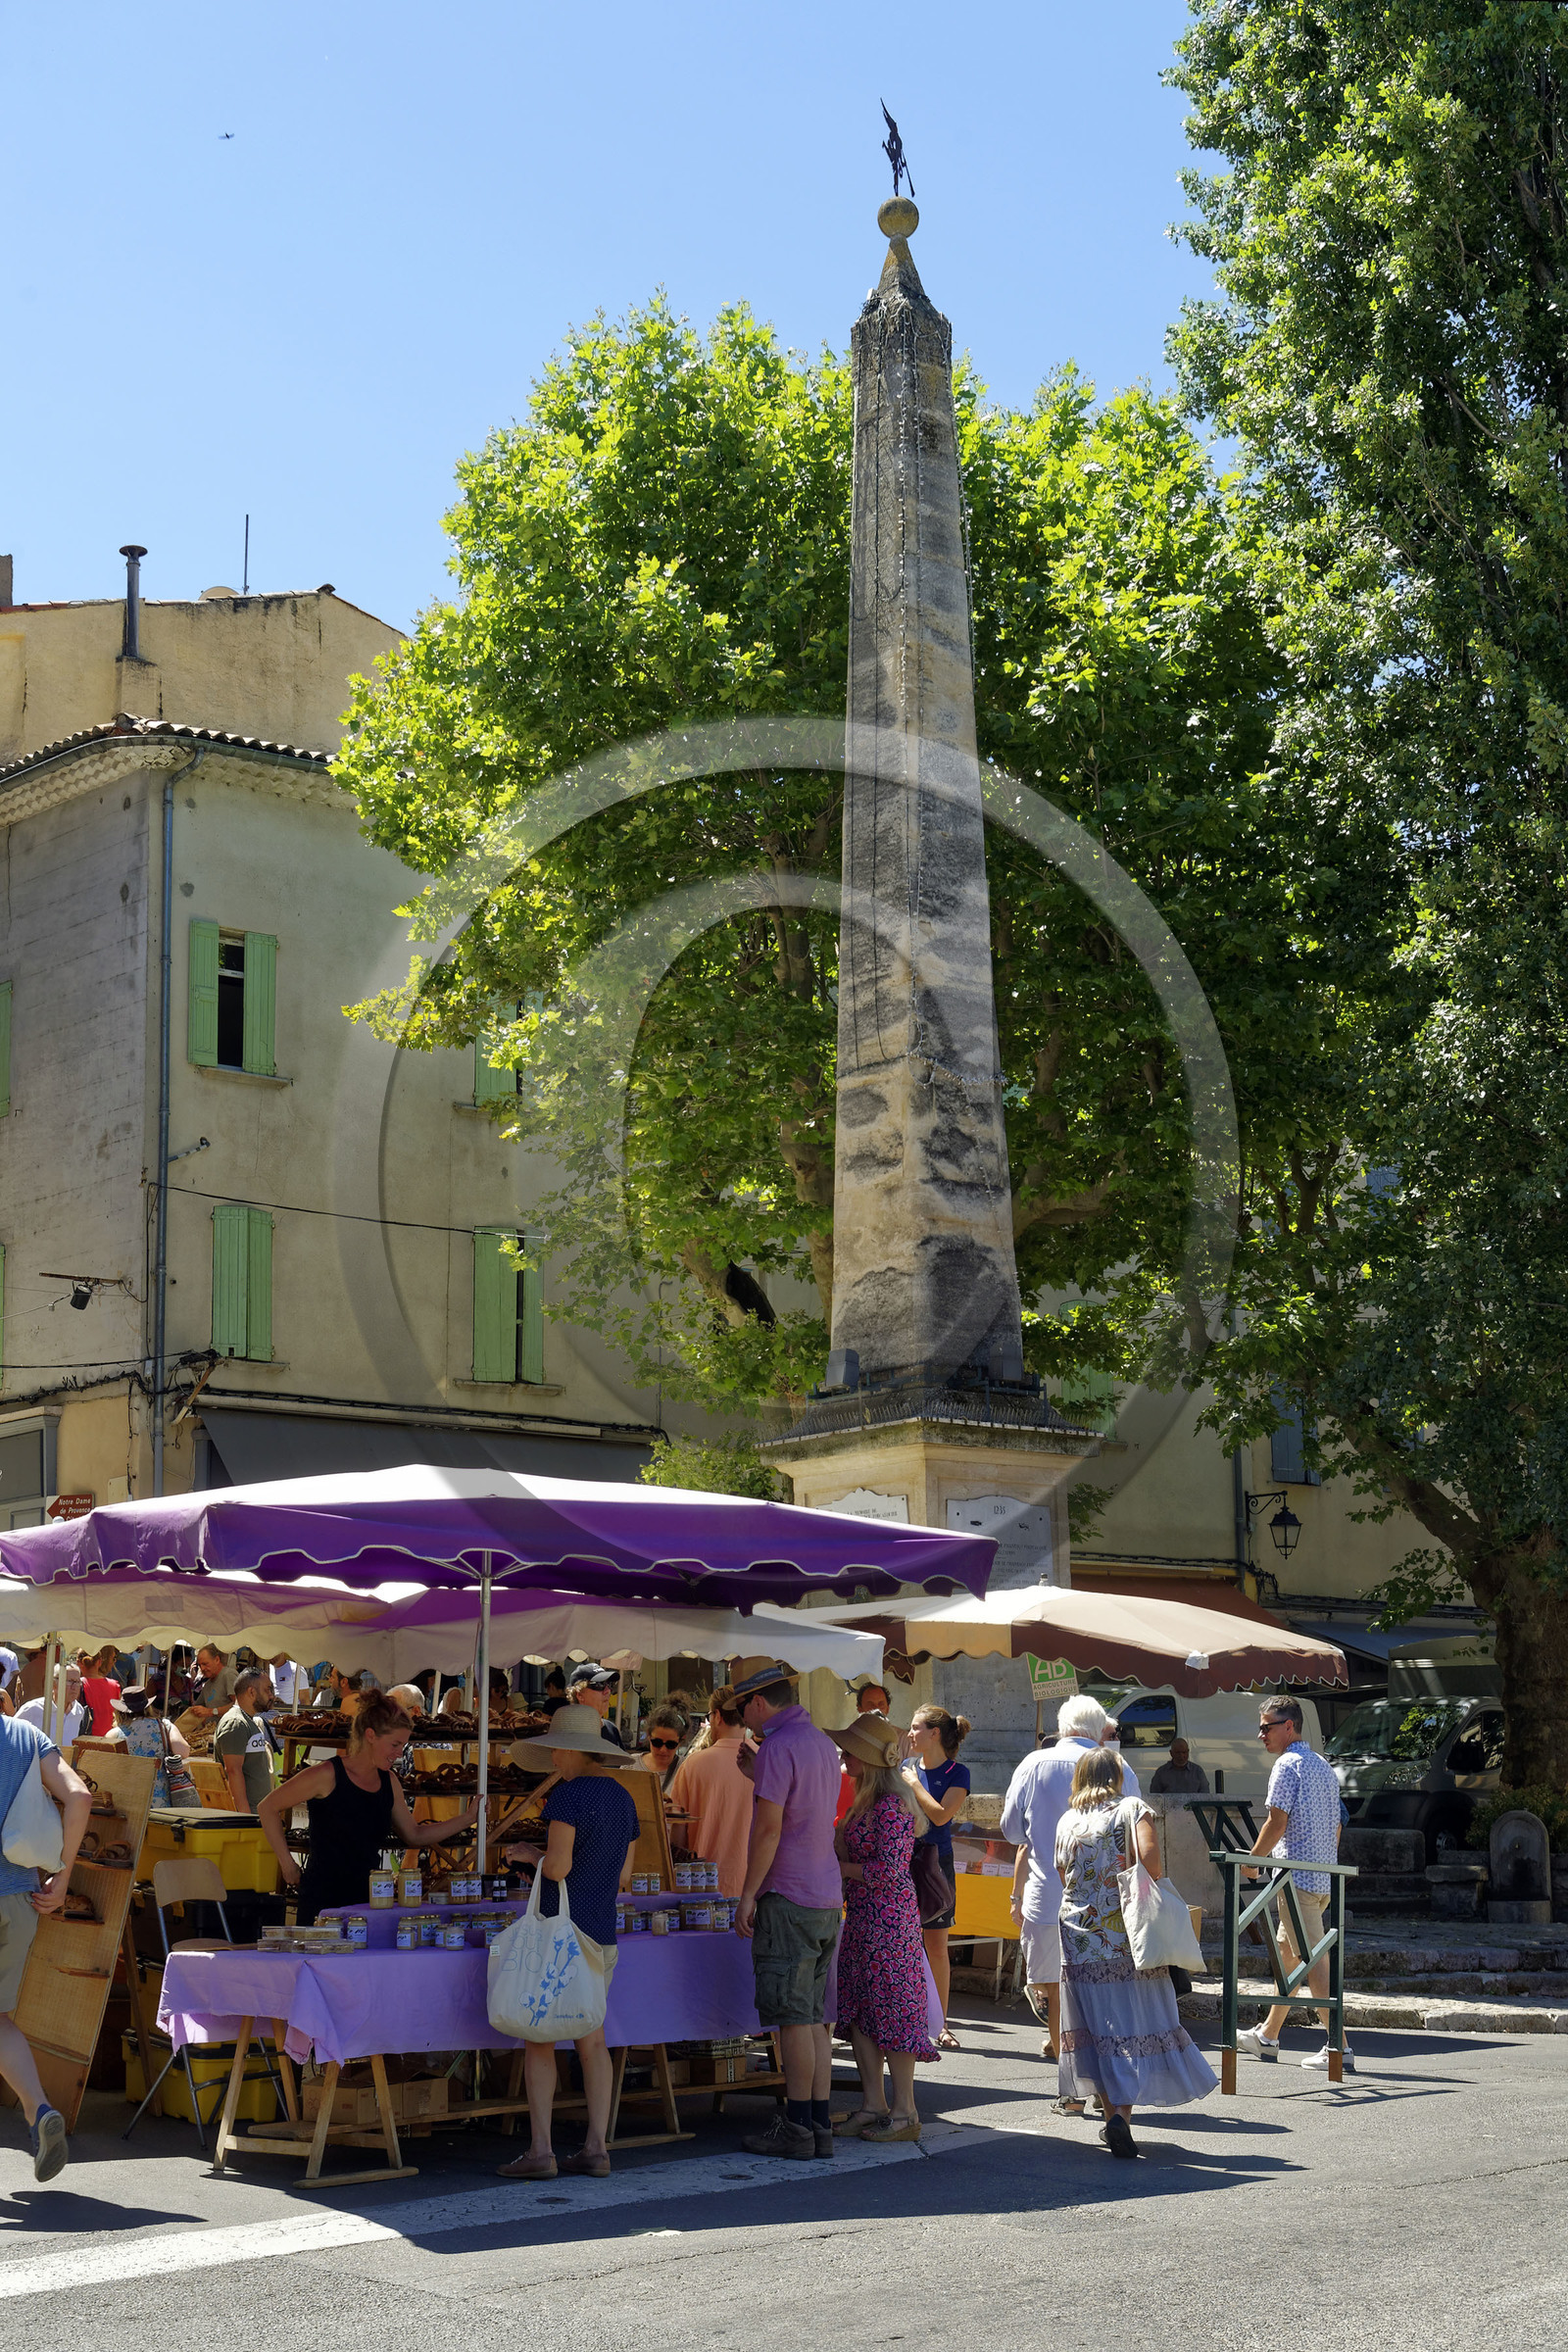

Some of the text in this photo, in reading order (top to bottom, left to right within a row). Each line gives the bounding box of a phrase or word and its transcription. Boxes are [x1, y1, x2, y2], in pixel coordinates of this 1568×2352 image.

[994, 1505, 1005, 1515] 1235
[1033, 1679, 1076, 1690] AGRICULTURE
[1034, 1686, 1076, 1696] BIOLOGIQUE
[501, 1949, 542, 1974] BIO
